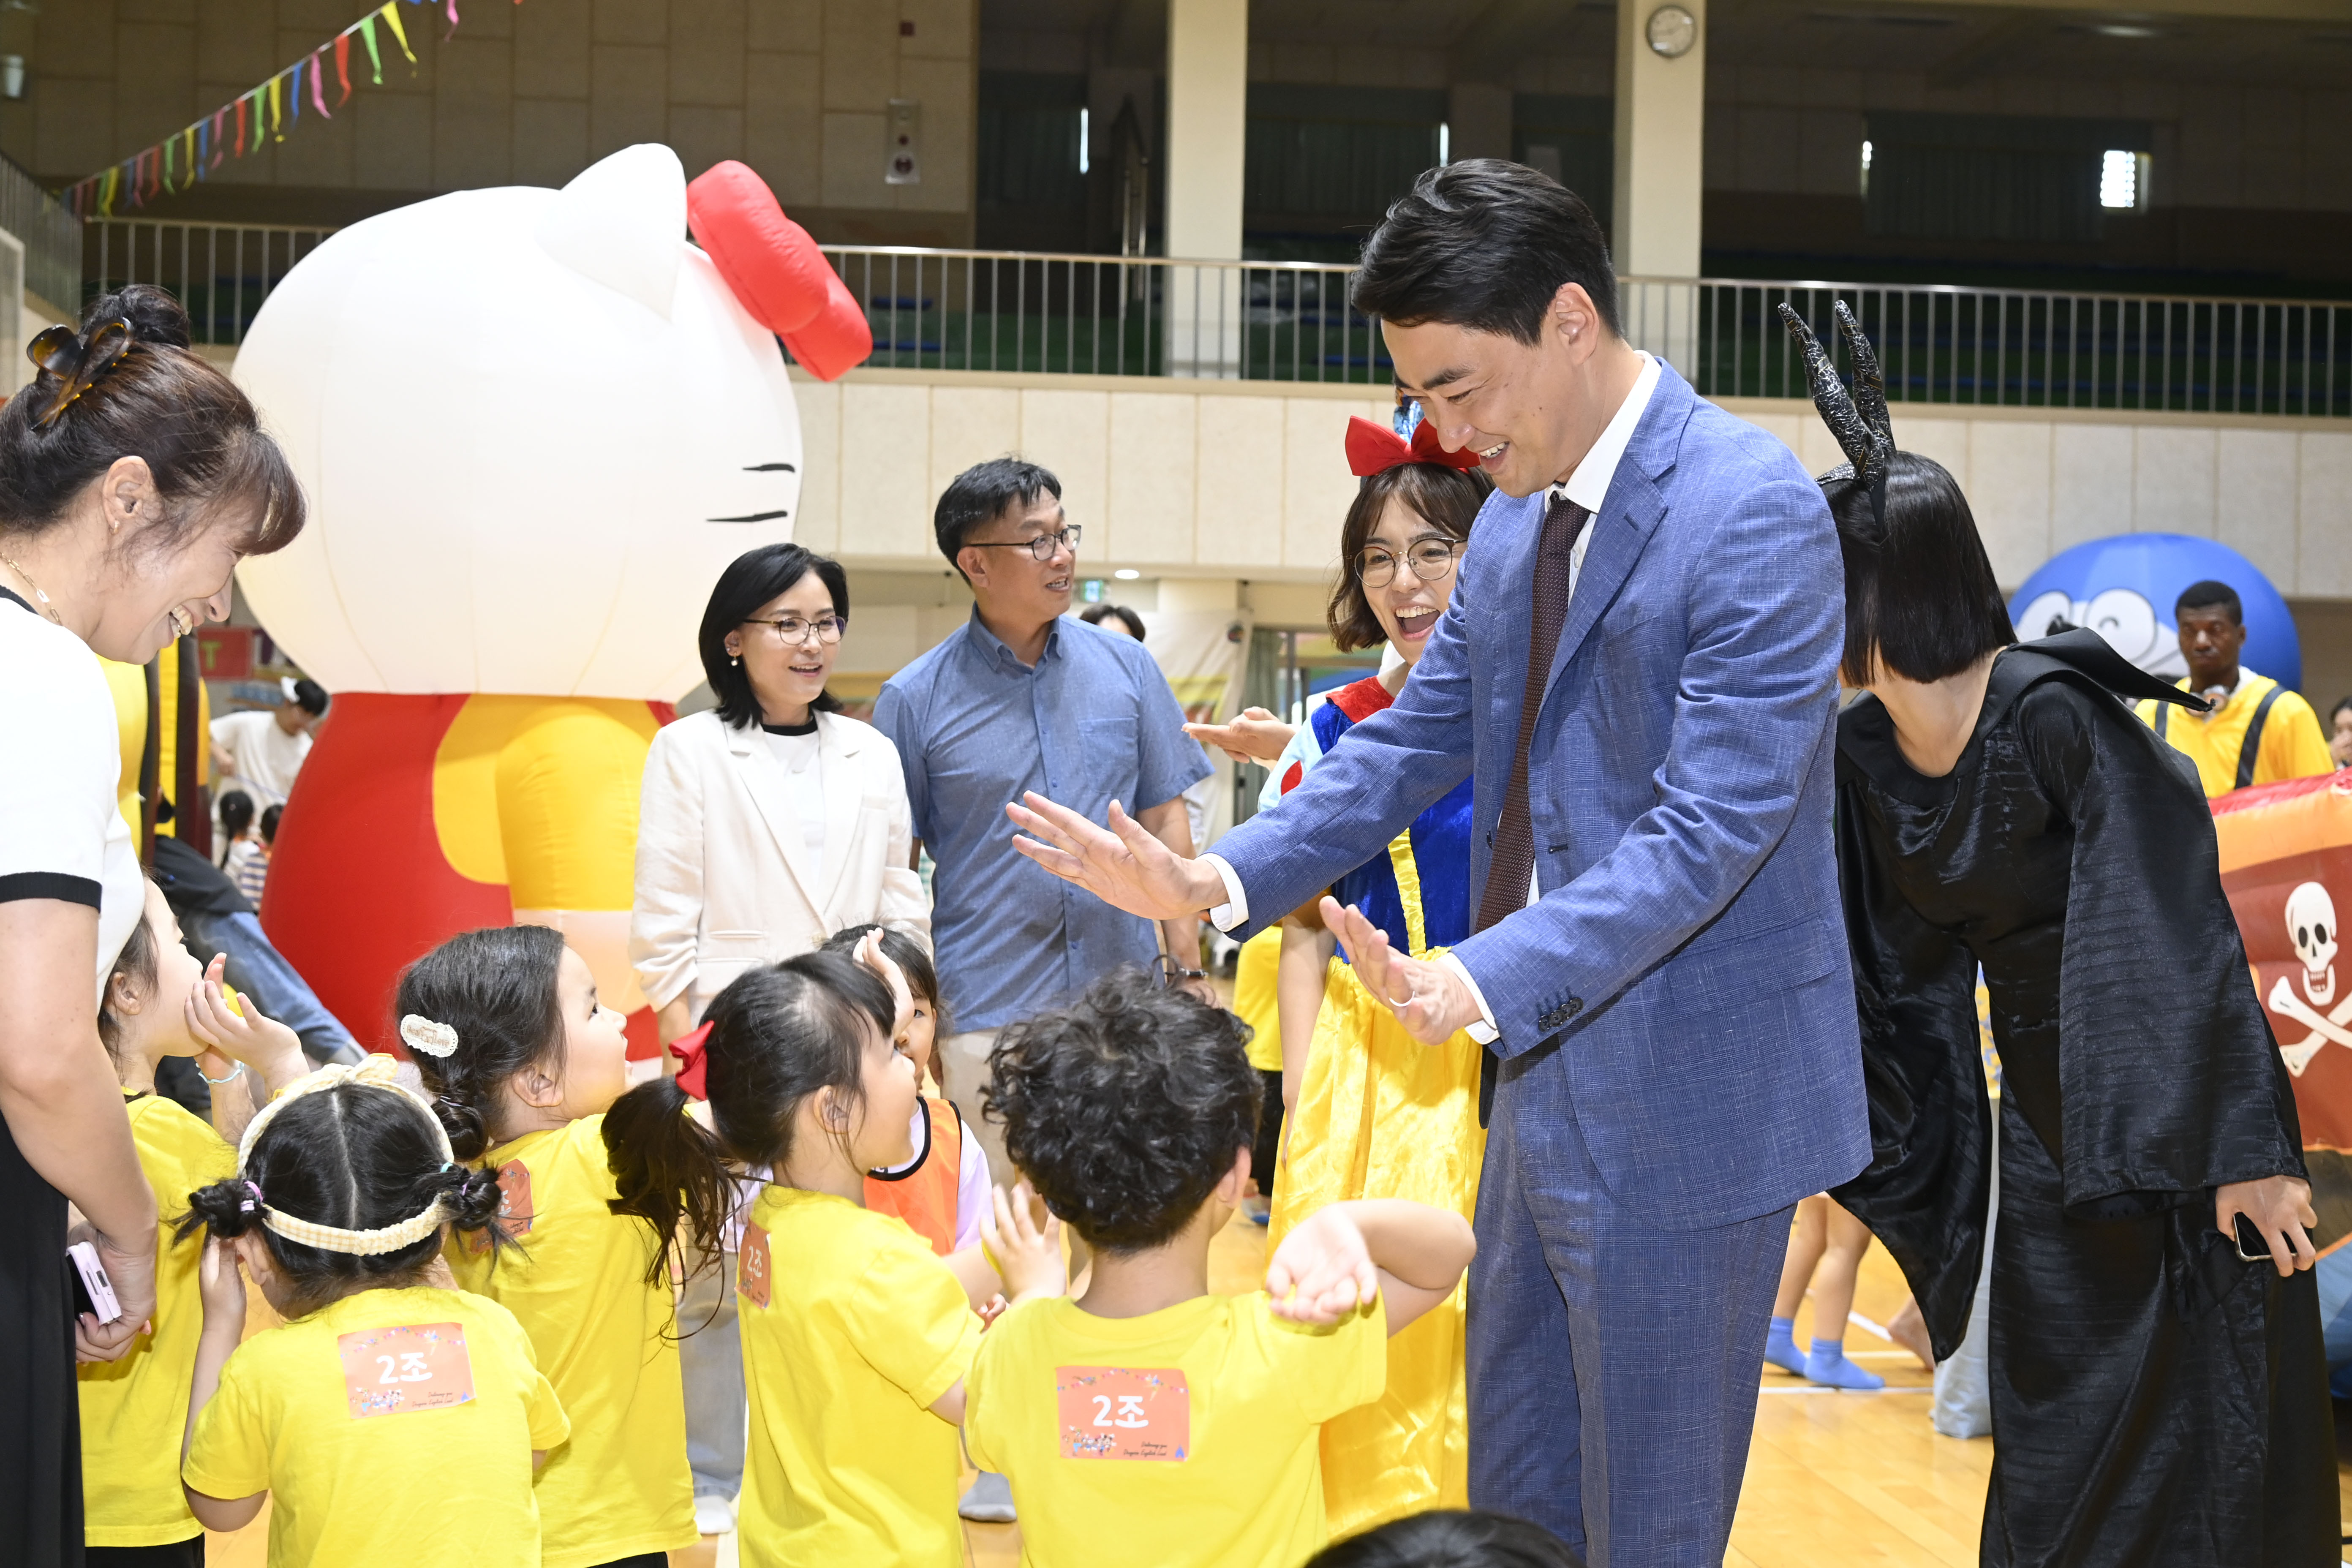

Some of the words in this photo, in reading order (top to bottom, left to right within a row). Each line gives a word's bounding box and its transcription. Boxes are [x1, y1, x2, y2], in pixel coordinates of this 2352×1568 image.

[747, 1245, 762, 1278] 2조
[376, 1352, 433, 1384] 2조
[1092, 1395, 1149, 1428] 2조
